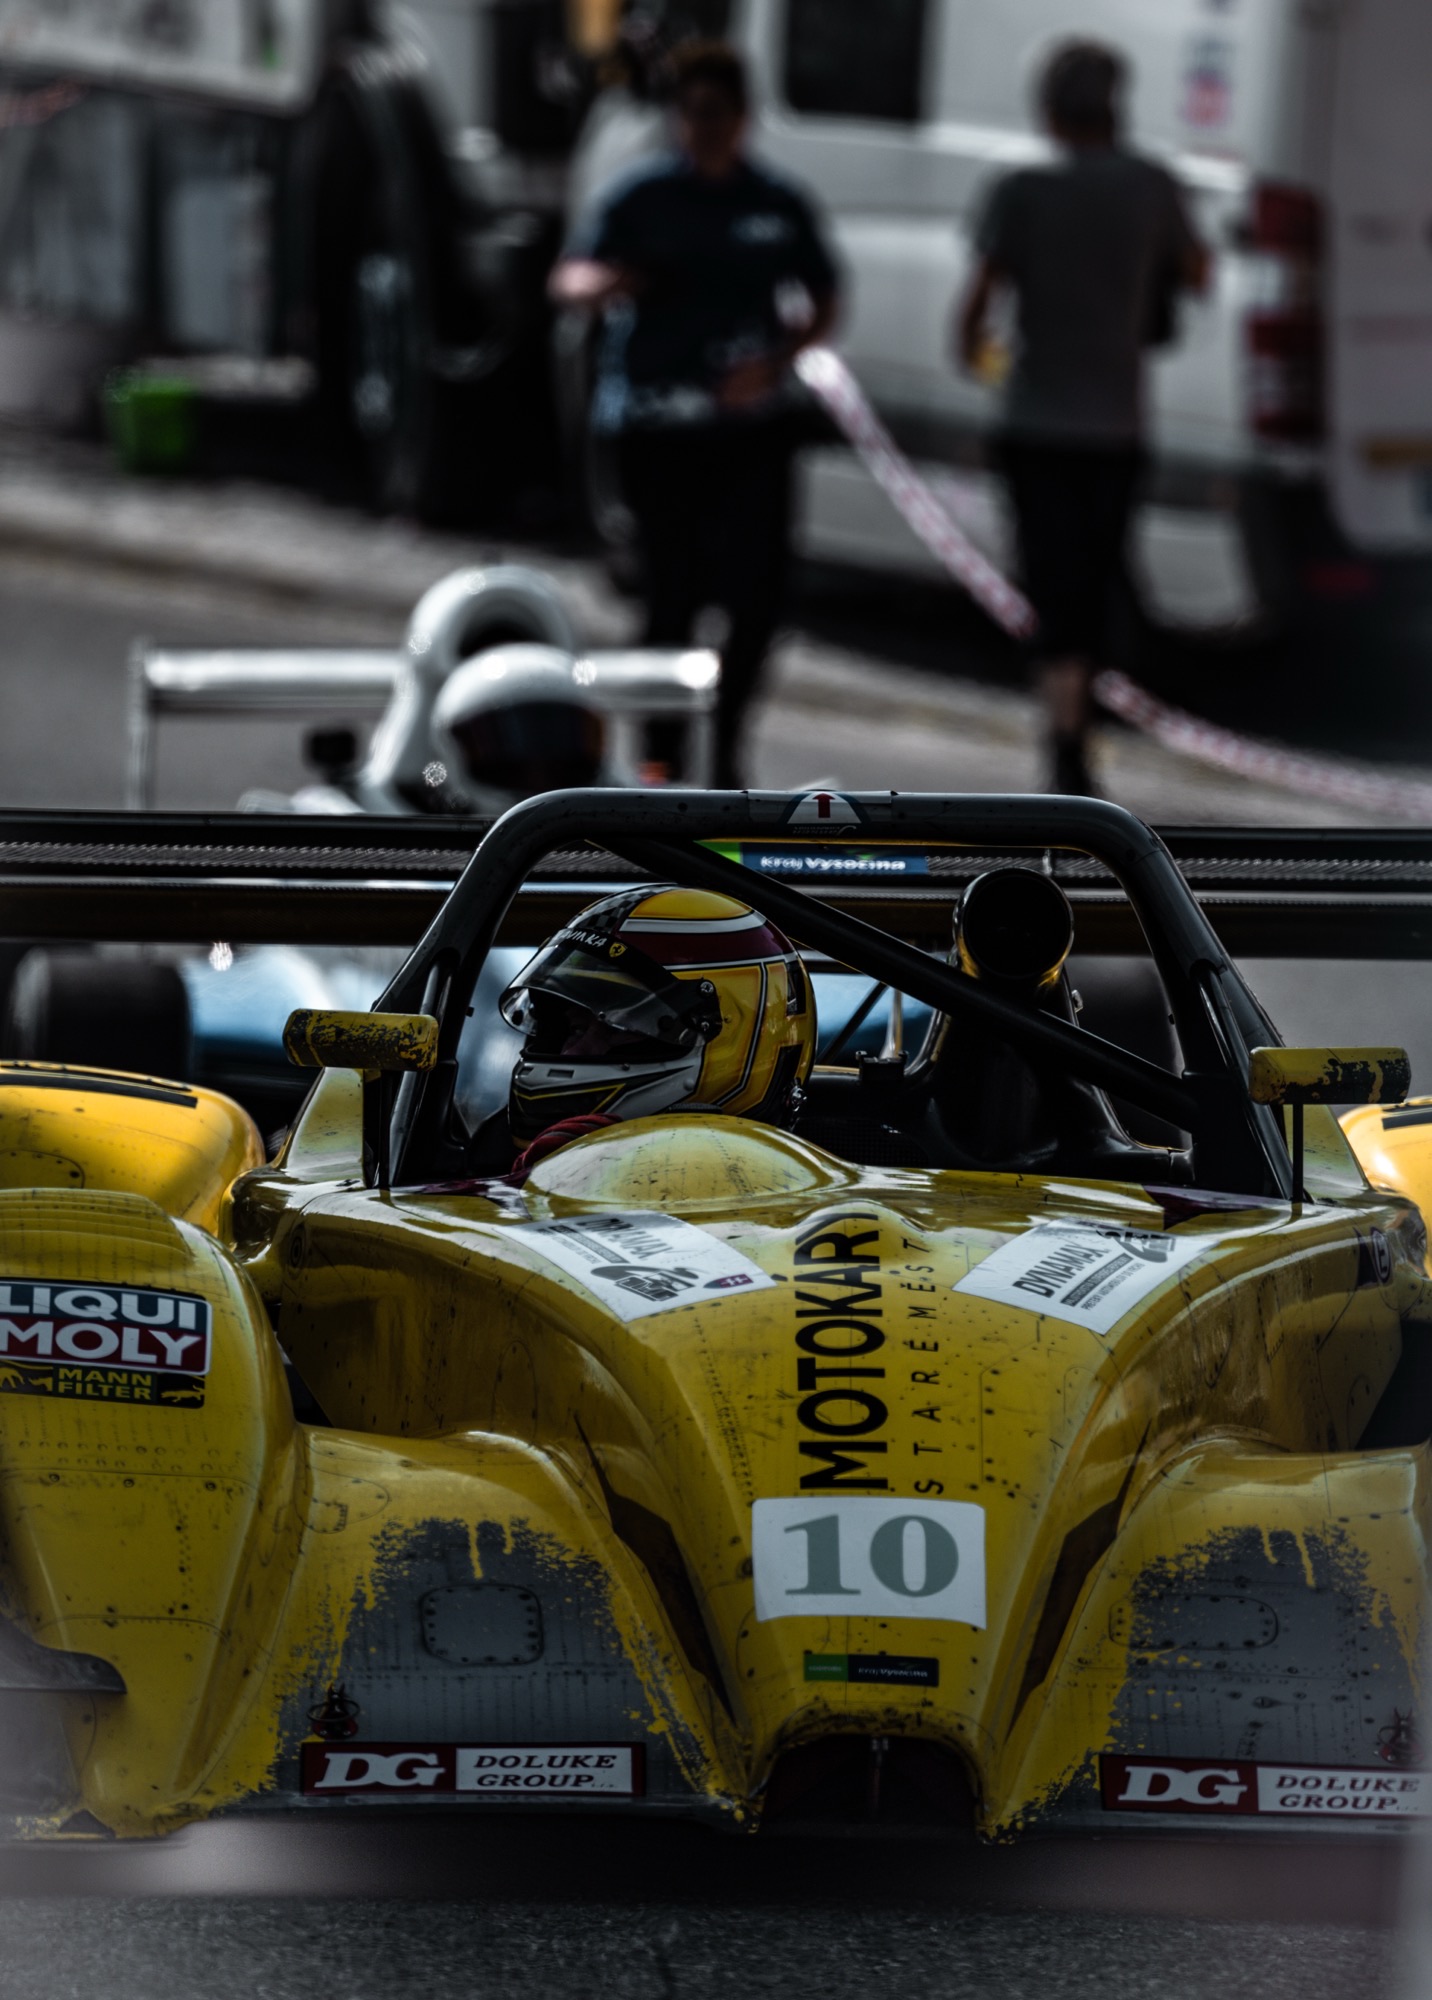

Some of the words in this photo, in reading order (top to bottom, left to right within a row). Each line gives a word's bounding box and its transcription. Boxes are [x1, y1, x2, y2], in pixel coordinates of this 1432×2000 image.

[0, 1285, 197, 1330] LIQUI
[0, 1318, 201, 1366] MOLY
[58, 1368, 150, 1386] MANN
[58, 1382, 150, 1400] FILTER
[784, 1514, 959, 1598] 10
[314, 1753, 446, 1788] DG
[473, 1754, 618, 1769] DOLUKE
[476, 1774, 595, 1788] GROUP
[1118, 1765, 1248, 1805] DG
[1275, 1773, 1419, 1793] DOLUKE
[1279, 1793, 1398, 1811] GROUP
